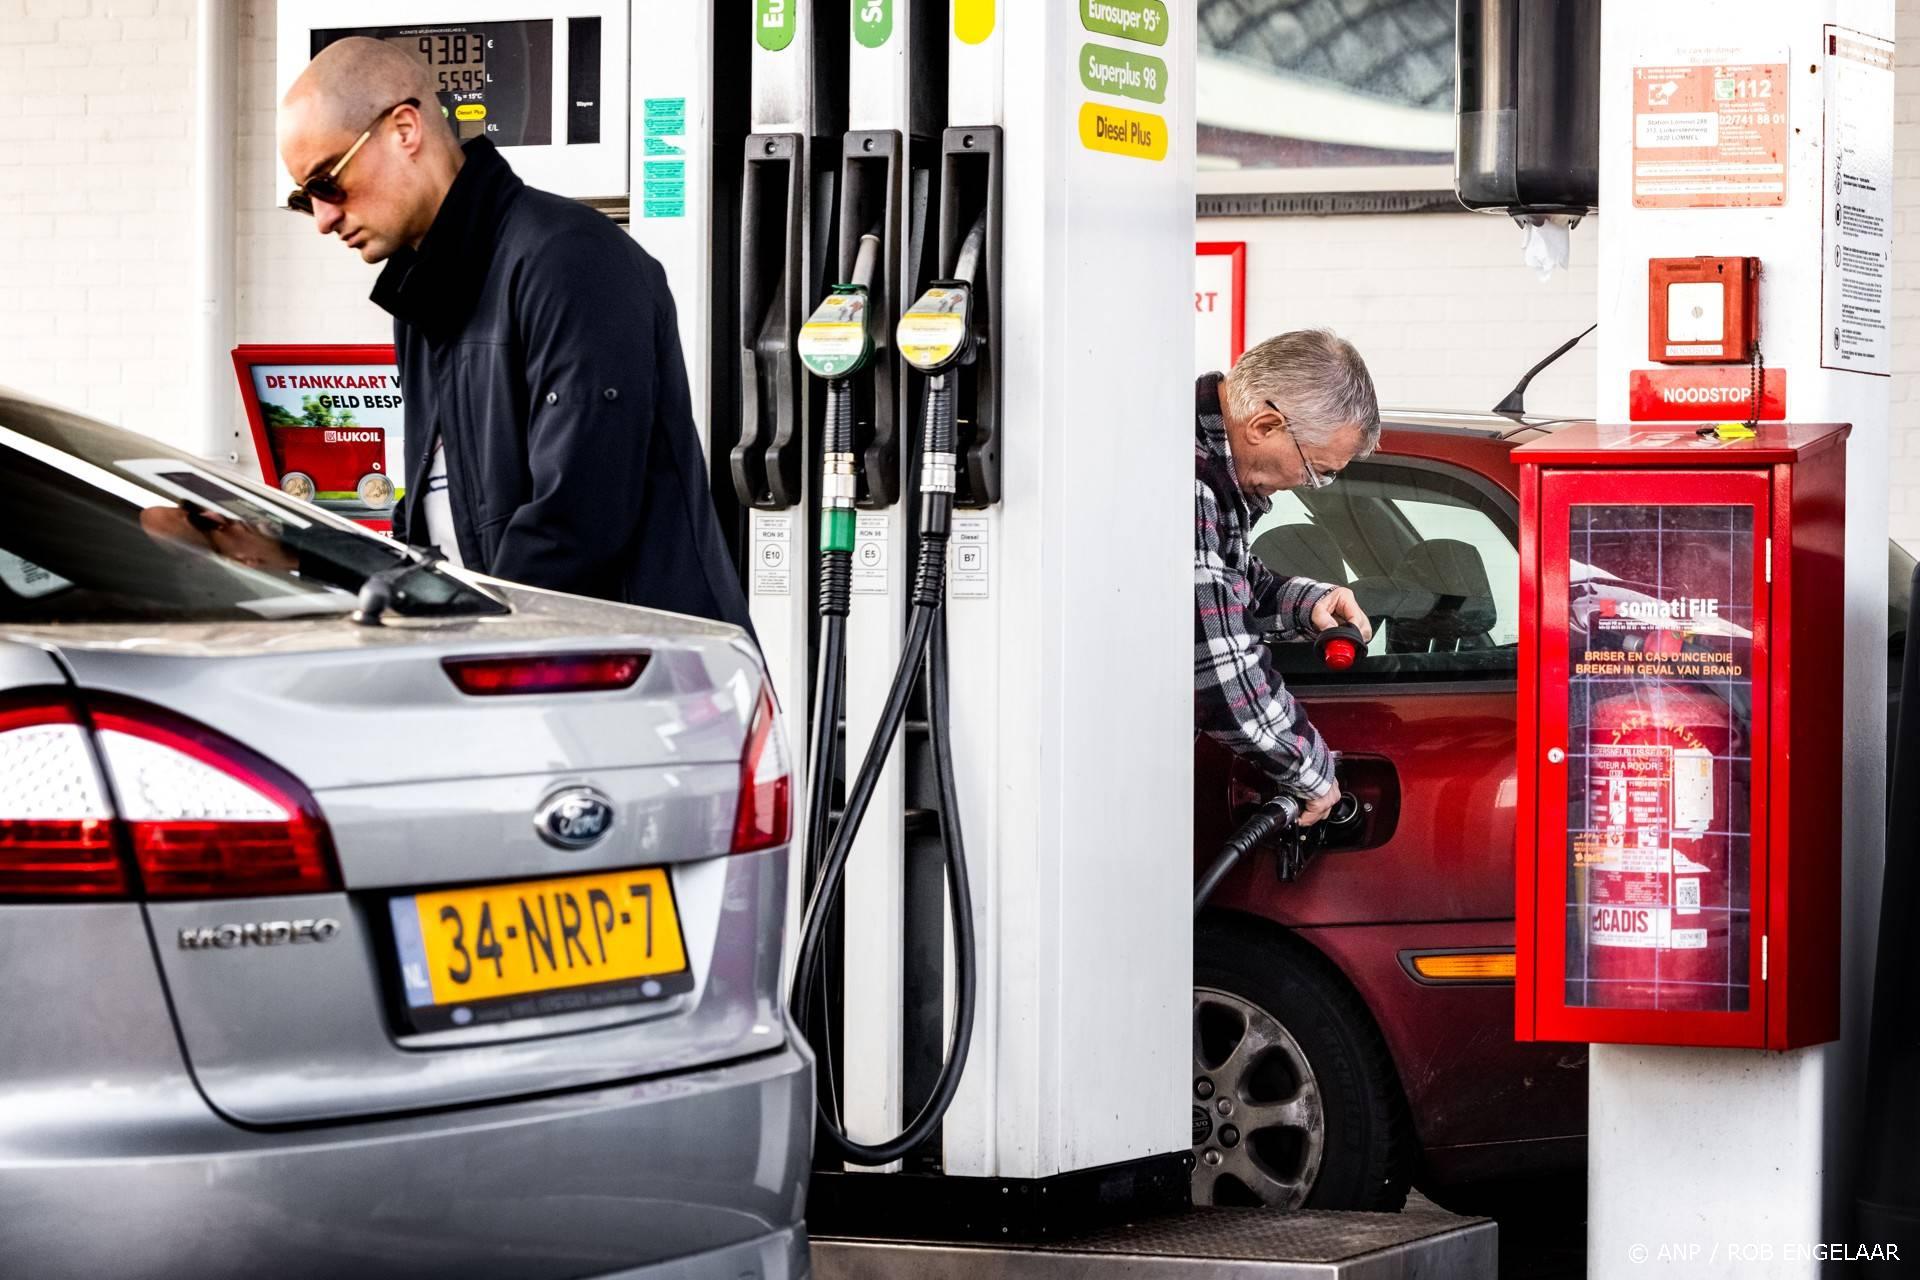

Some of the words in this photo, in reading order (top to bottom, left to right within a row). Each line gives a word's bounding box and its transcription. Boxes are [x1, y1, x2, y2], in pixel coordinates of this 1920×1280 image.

[1088, 0, 1141, 31] Eurosuper
[419, 35, 484, 65] 93.83
[1089, 55, 1141, 89] Superplus
[1143, 67, 1157, 90] 98
[1738, 79, 1772, 98] 112
[1096, 115, 1127, 142] Diesel
[1131, 121, 1151, 147] Plus
[265, 375, 287, 388] DE
[288, 375, 387, 389] TANKKAART
[319, 395, 360, 409] GELD
[1664, 387, 1751, 403] NOODSTOP
[337, 431, 381, 442] LUKOIL
[765, 551, 780, 560] E10
[865, 550, 876, 558] E5
[964, 553, 975, 562] B7
[1620, 597, 1686, 618] somati
[1584, 651, 1625, 662] BRISER
[1628, 652, 1643, 662] EN
[1645, 652, 1668, 662] CAS
[1671, 652, 1733, 663] D'INCENDIE
[1576, 664, 1621, 675] BREKEN
[1624, 664, 1634, 674] IN
[1637, 664, 1674, 675] GEVAL
[1677, 665, 1700, 675] VAN
[1703, 665, 1742, 676] BRAND
[557, 799, 606, 836] Ford
[178, 918, 341, 950] MONDEO
[439, 883, 653, 985] 34-NRP-7
